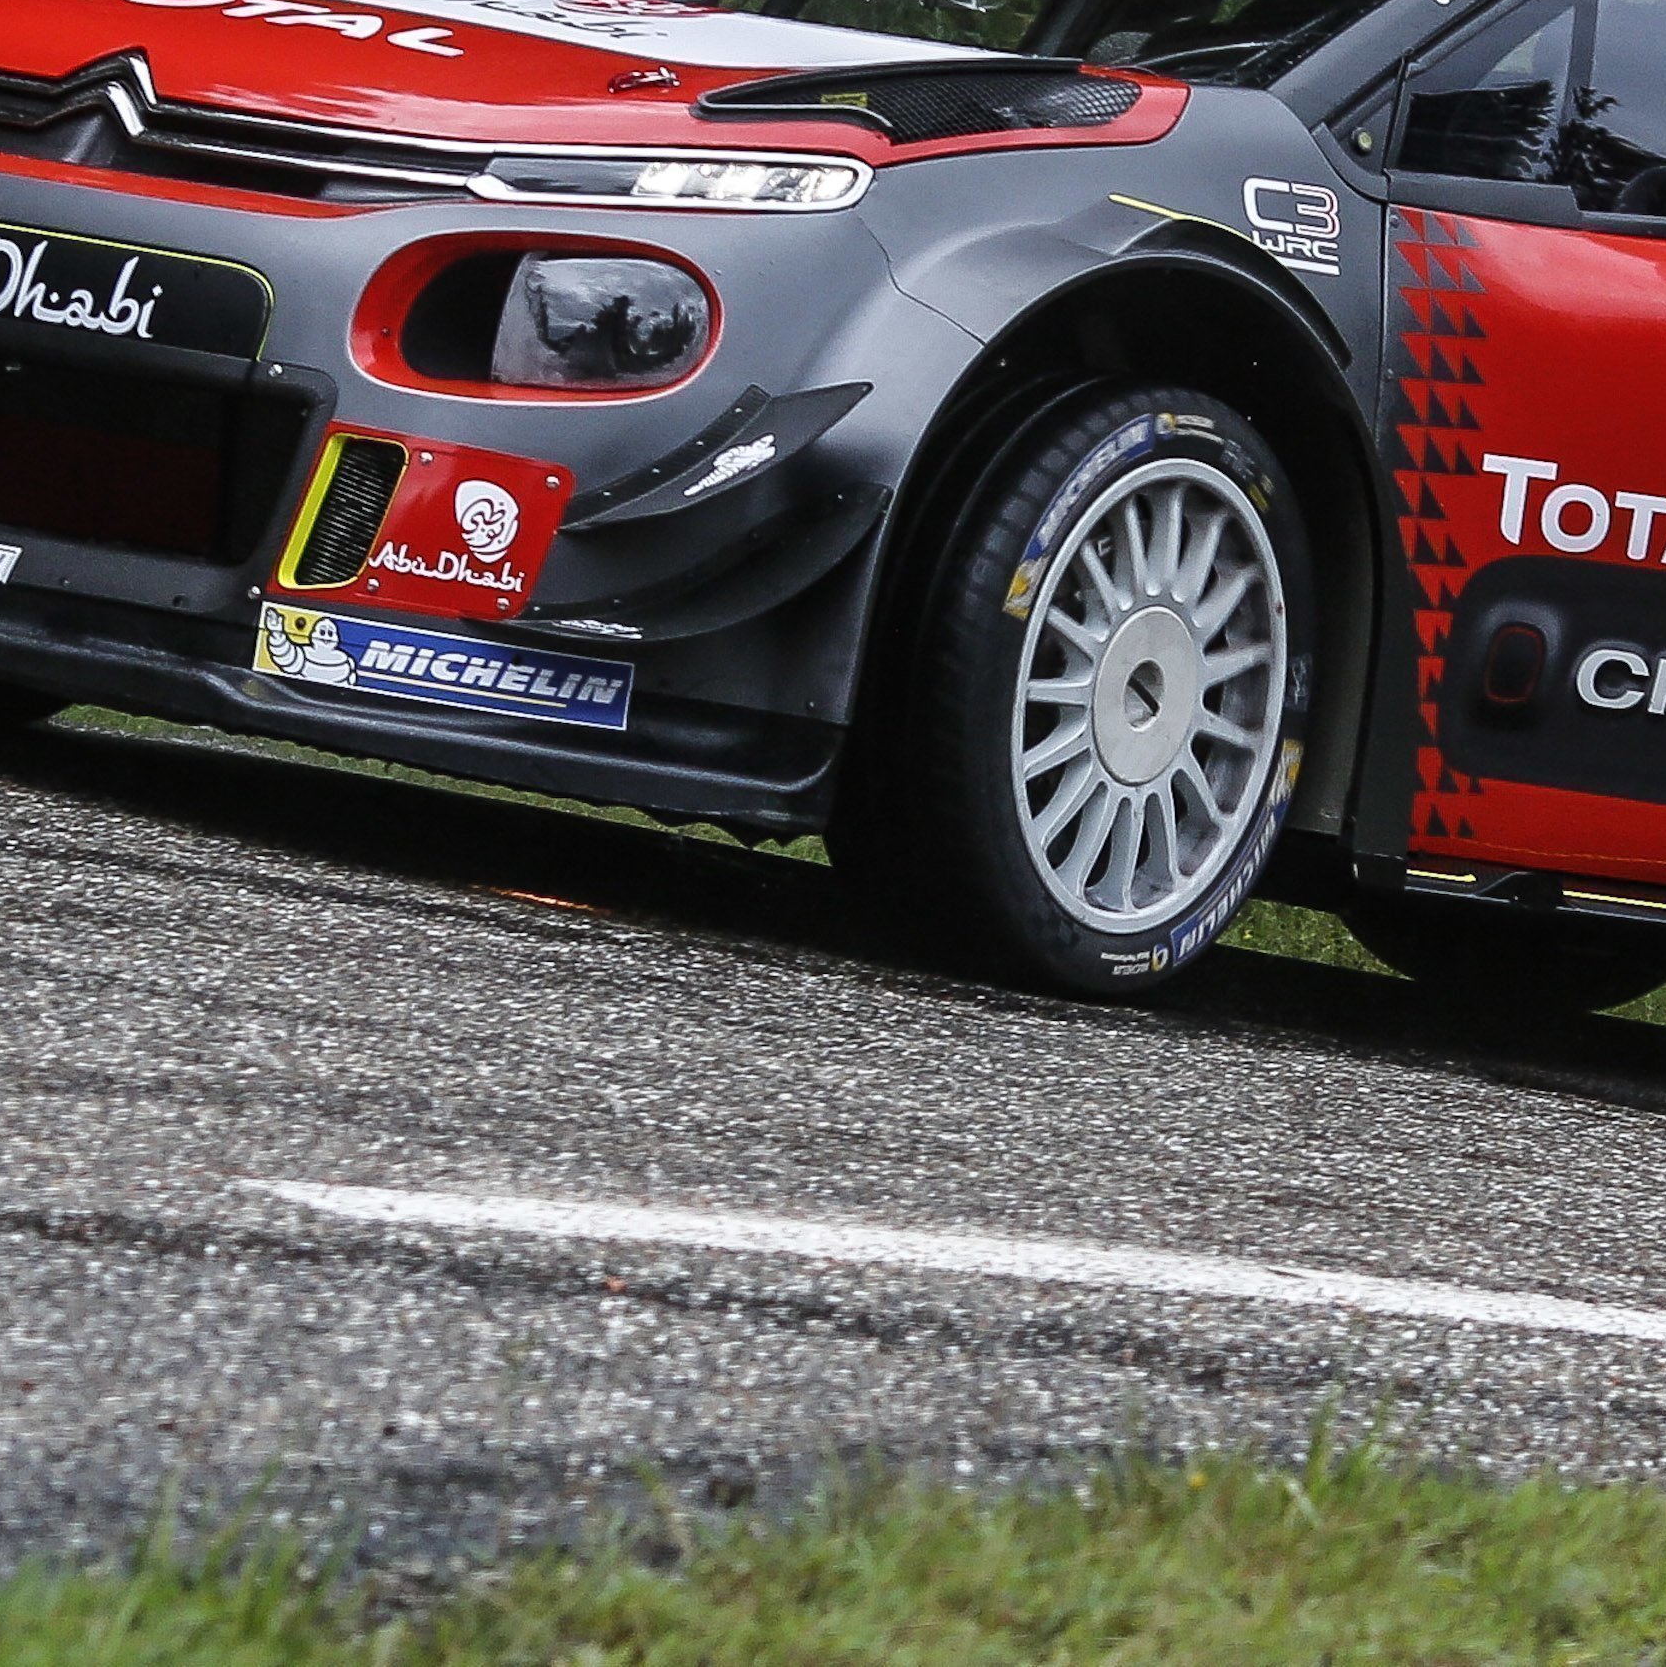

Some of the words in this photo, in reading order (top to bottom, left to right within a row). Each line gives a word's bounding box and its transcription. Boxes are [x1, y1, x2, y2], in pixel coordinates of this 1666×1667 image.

[1243, 177, 1341, 239] C3
[1252, 230, 1339, 262] WRC
[359, 639, 624, 704] MICHELIN
